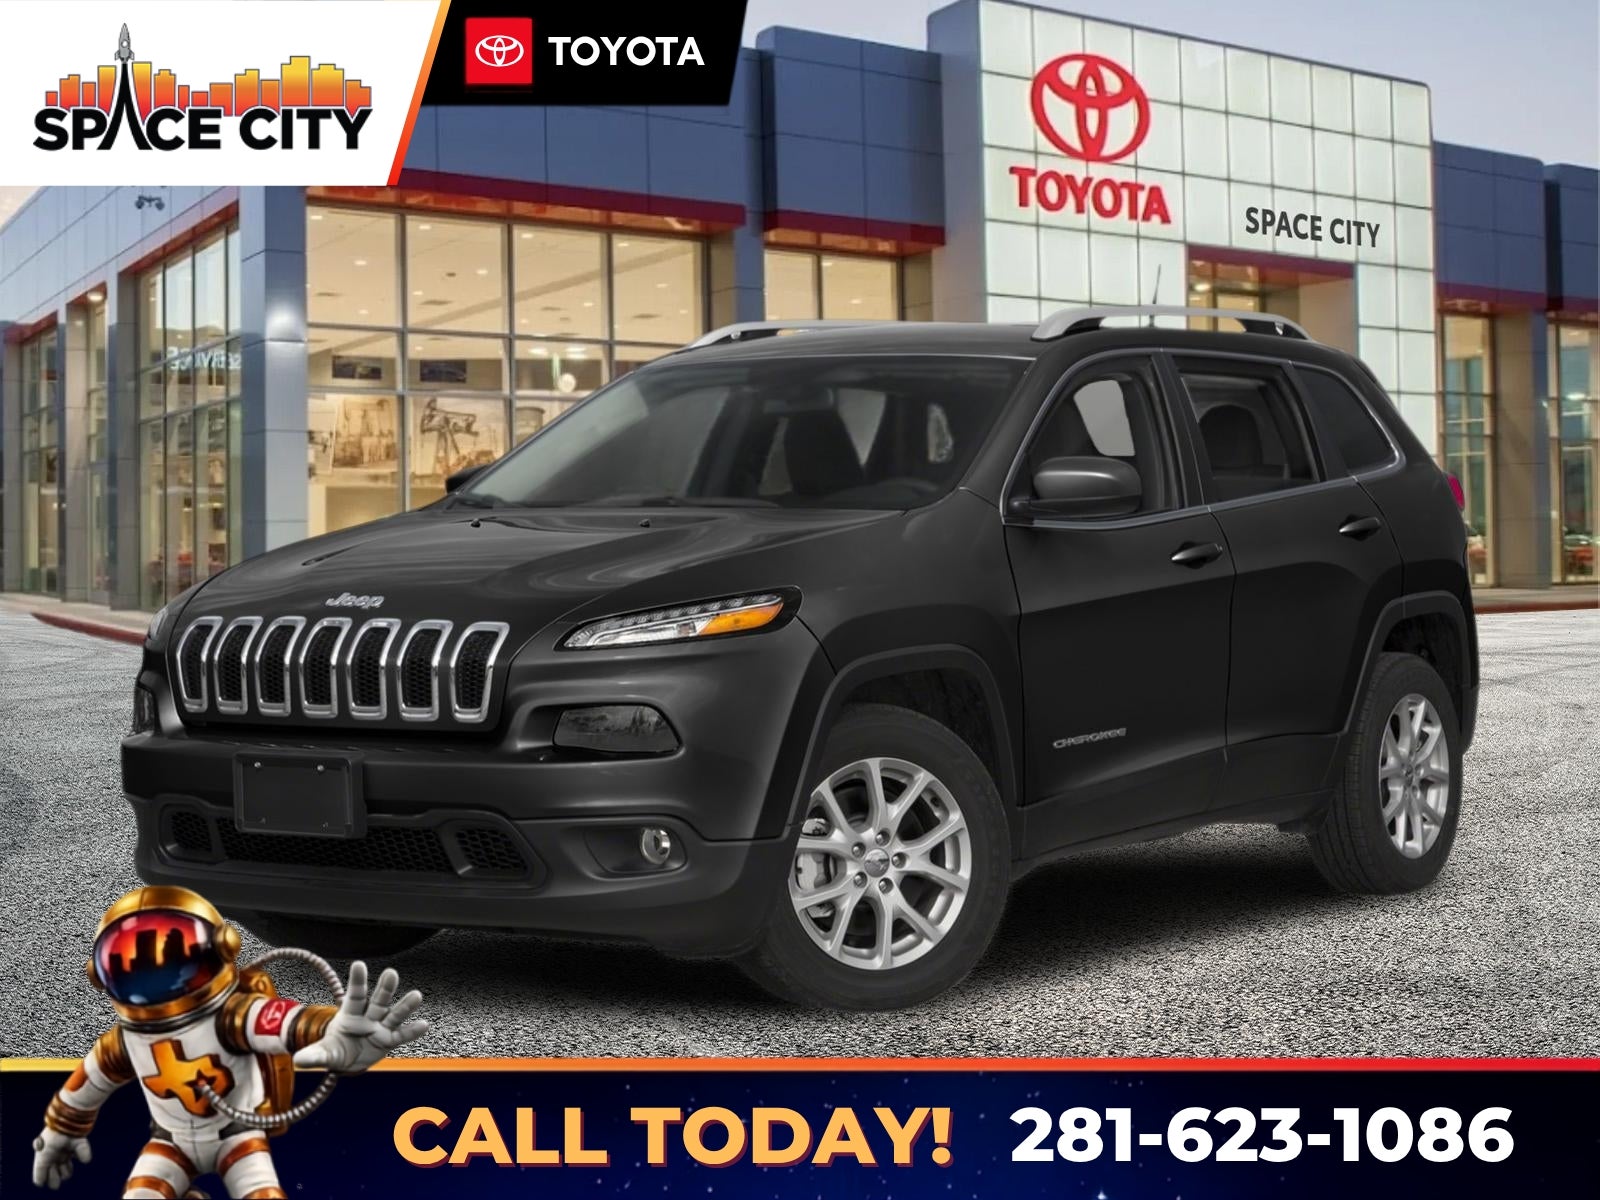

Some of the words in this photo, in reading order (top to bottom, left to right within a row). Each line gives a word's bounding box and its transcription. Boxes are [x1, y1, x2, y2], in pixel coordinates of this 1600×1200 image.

[1009, 166, 1171, 225] TOYOTA
[1245, 206, 1322, 242] SPACE
[1329, 217, 1381, 248] CITY
[325, 591, 385, 609] Jeep
